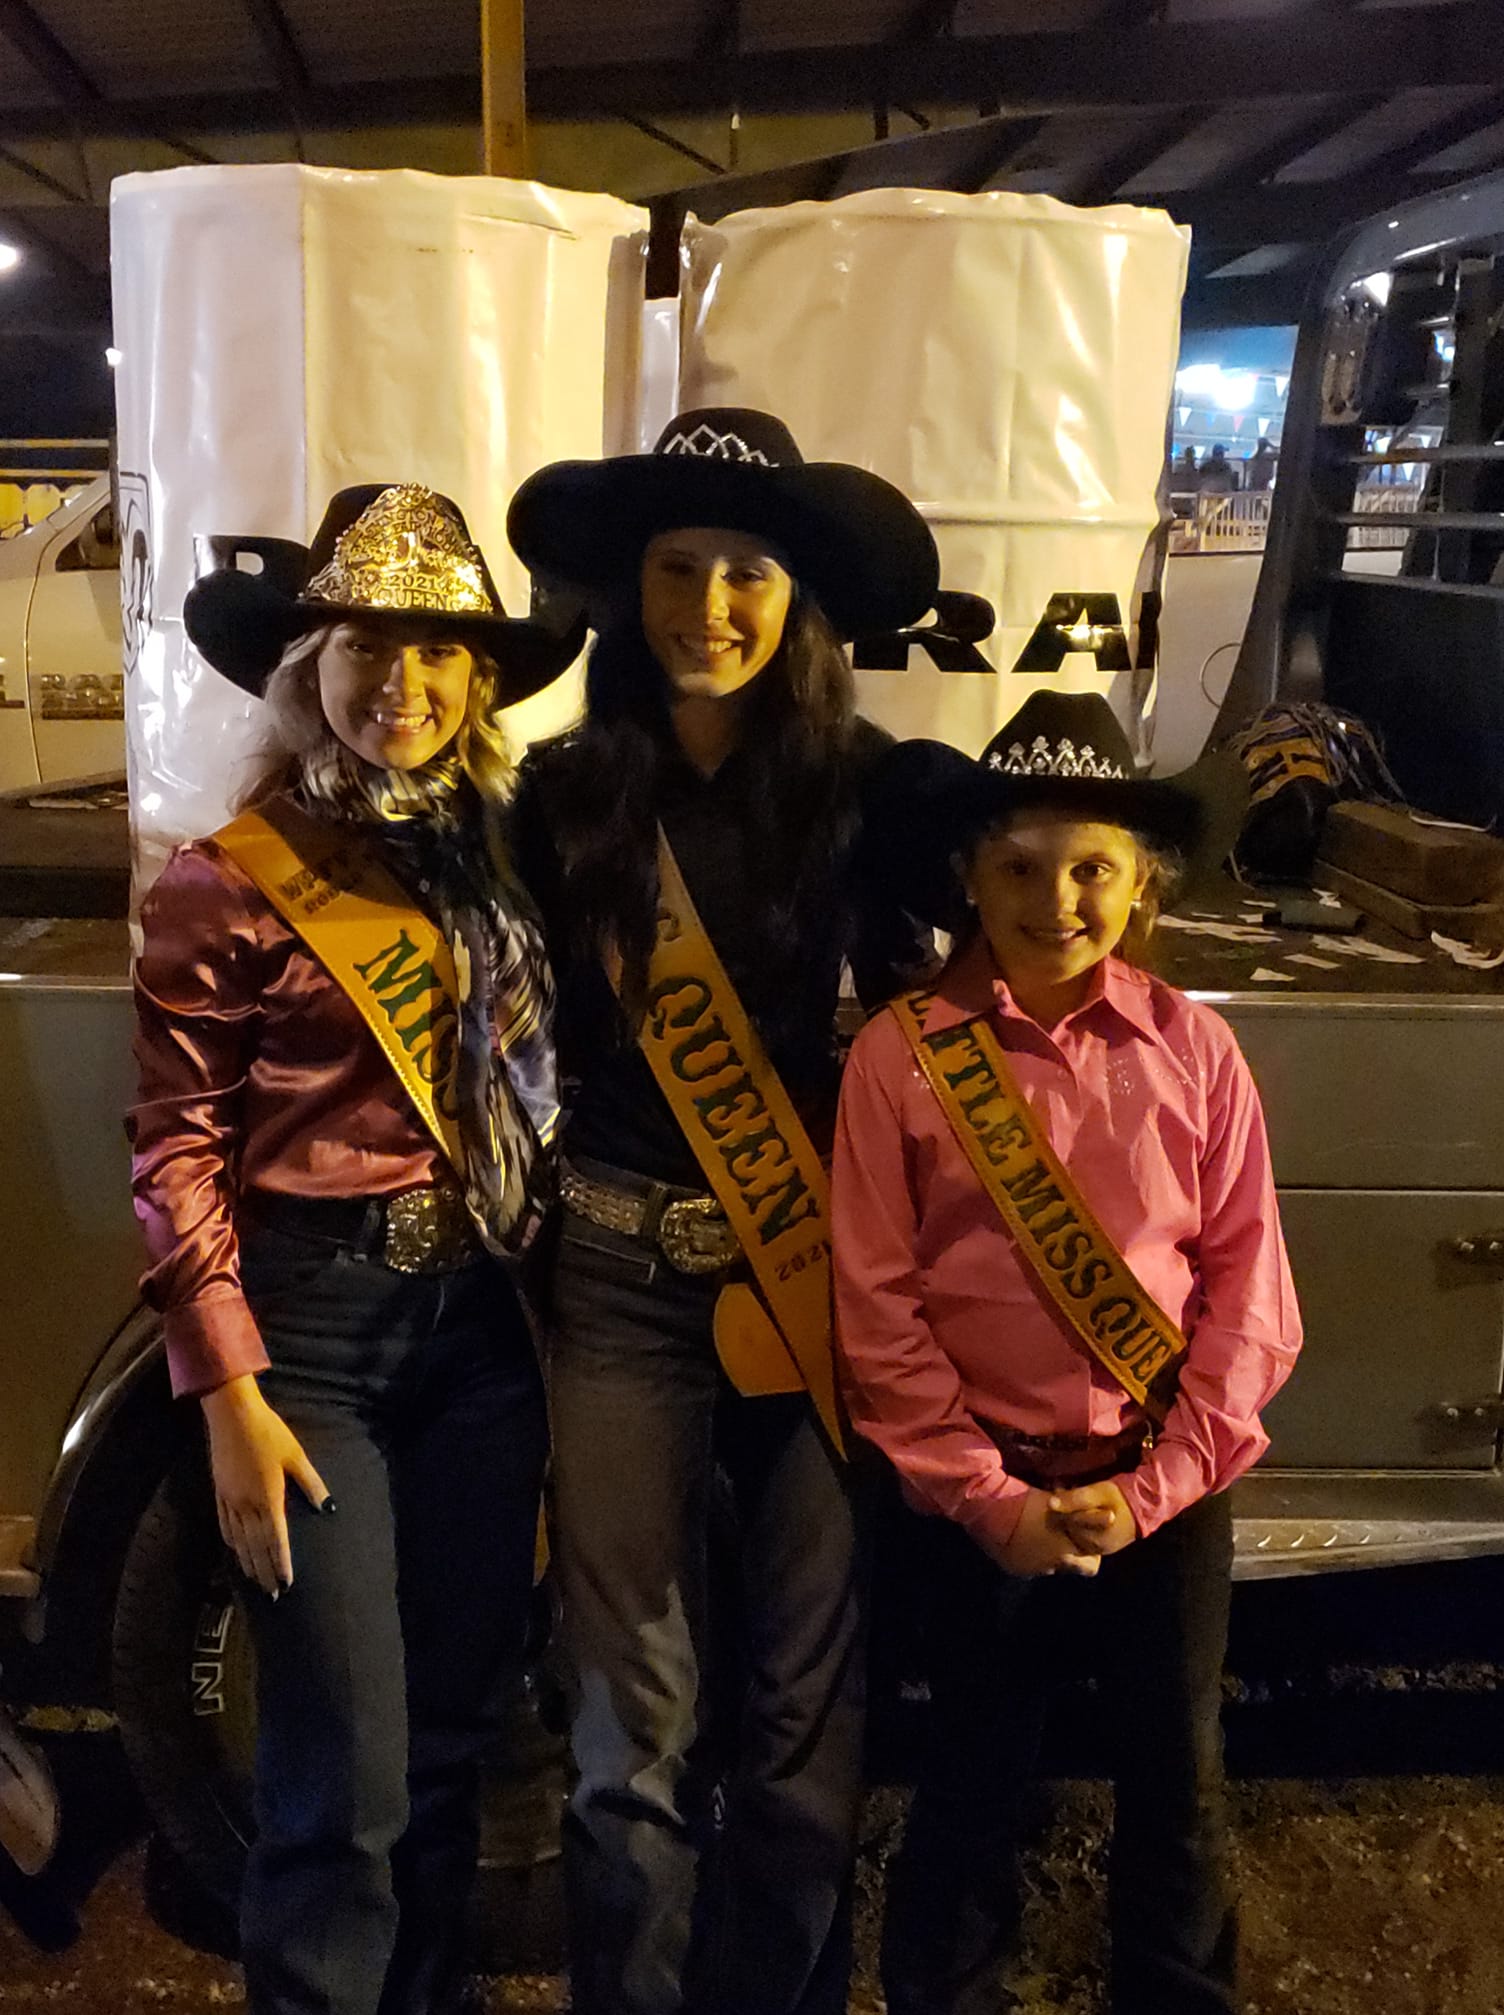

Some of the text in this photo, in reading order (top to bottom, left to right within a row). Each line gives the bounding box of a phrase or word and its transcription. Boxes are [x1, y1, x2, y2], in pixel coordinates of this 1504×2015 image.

[376, 586, 450, 609] QUEEN
[388, 574, 439, 592] 2021
[851, 589, 1162, 674] RA
[649, 976, 820, 1244] QUEEN
[1001, 1159, 1111, 1299] MISS
